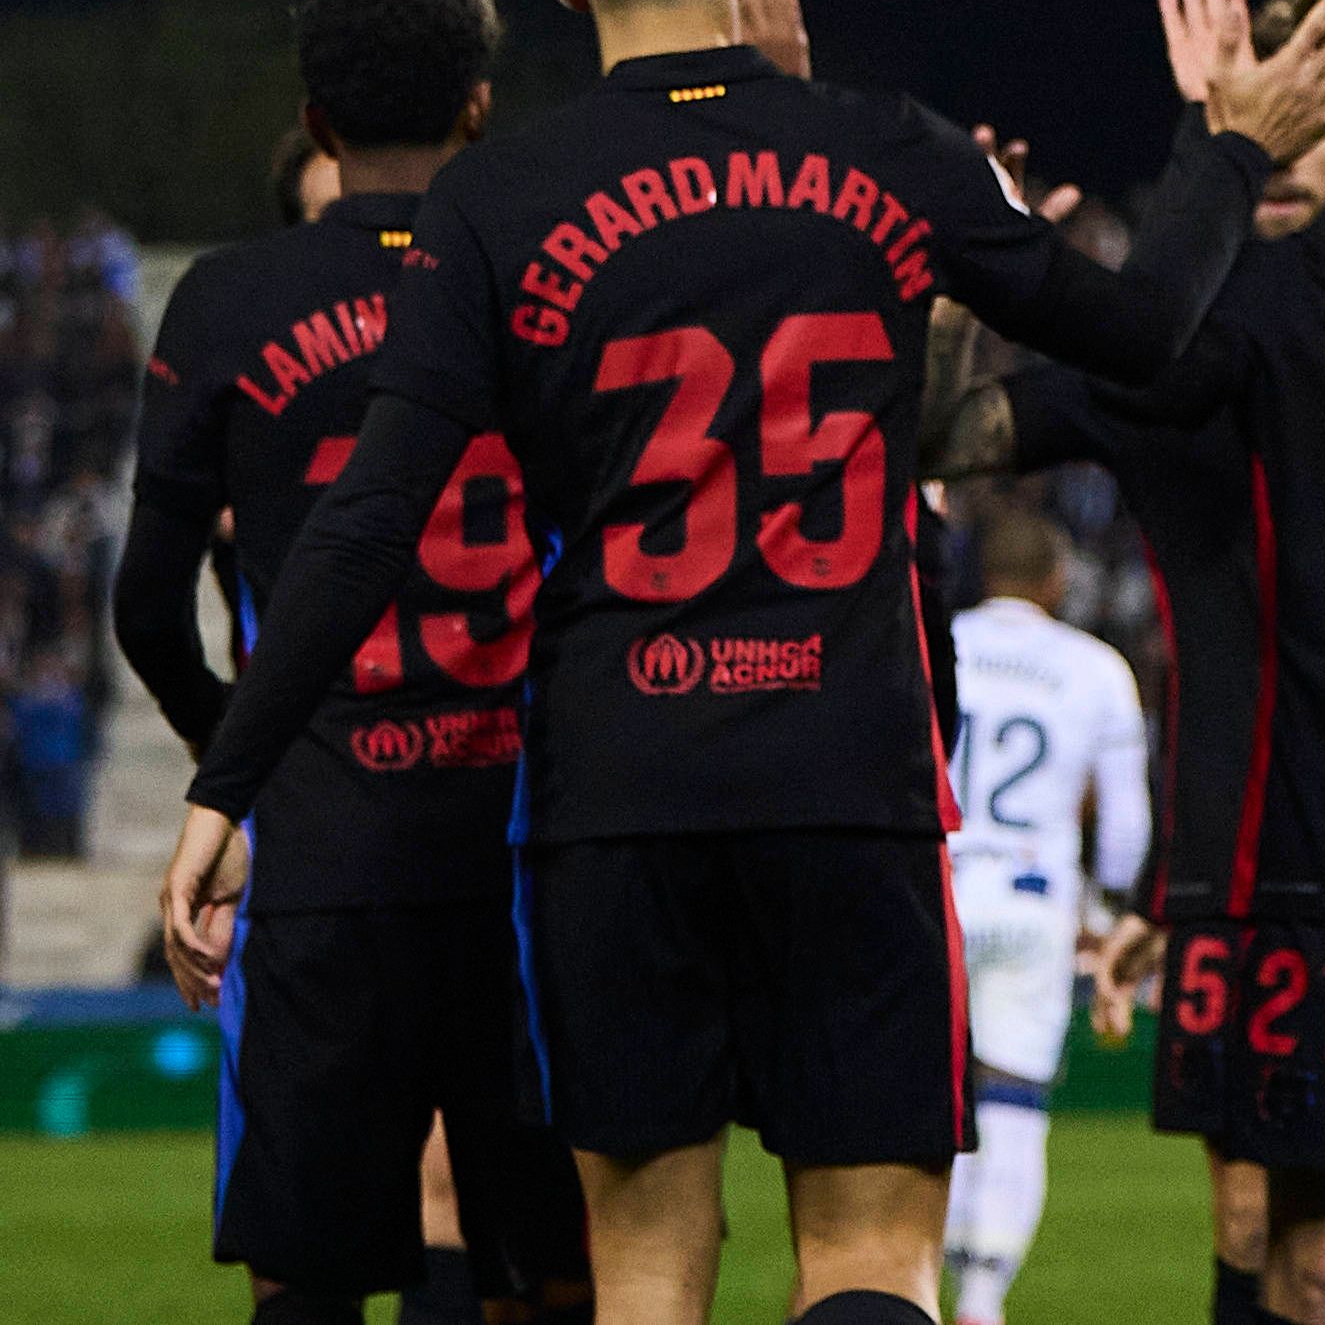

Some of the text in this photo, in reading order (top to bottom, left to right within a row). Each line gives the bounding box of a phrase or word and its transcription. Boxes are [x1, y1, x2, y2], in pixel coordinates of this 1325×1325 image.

[511, 156, 717, 348] GERARD
[593, 311, 896, 604] 35
[958, 714, 1047, 828] 12
[1176, 935, 1231, 1035] 5
